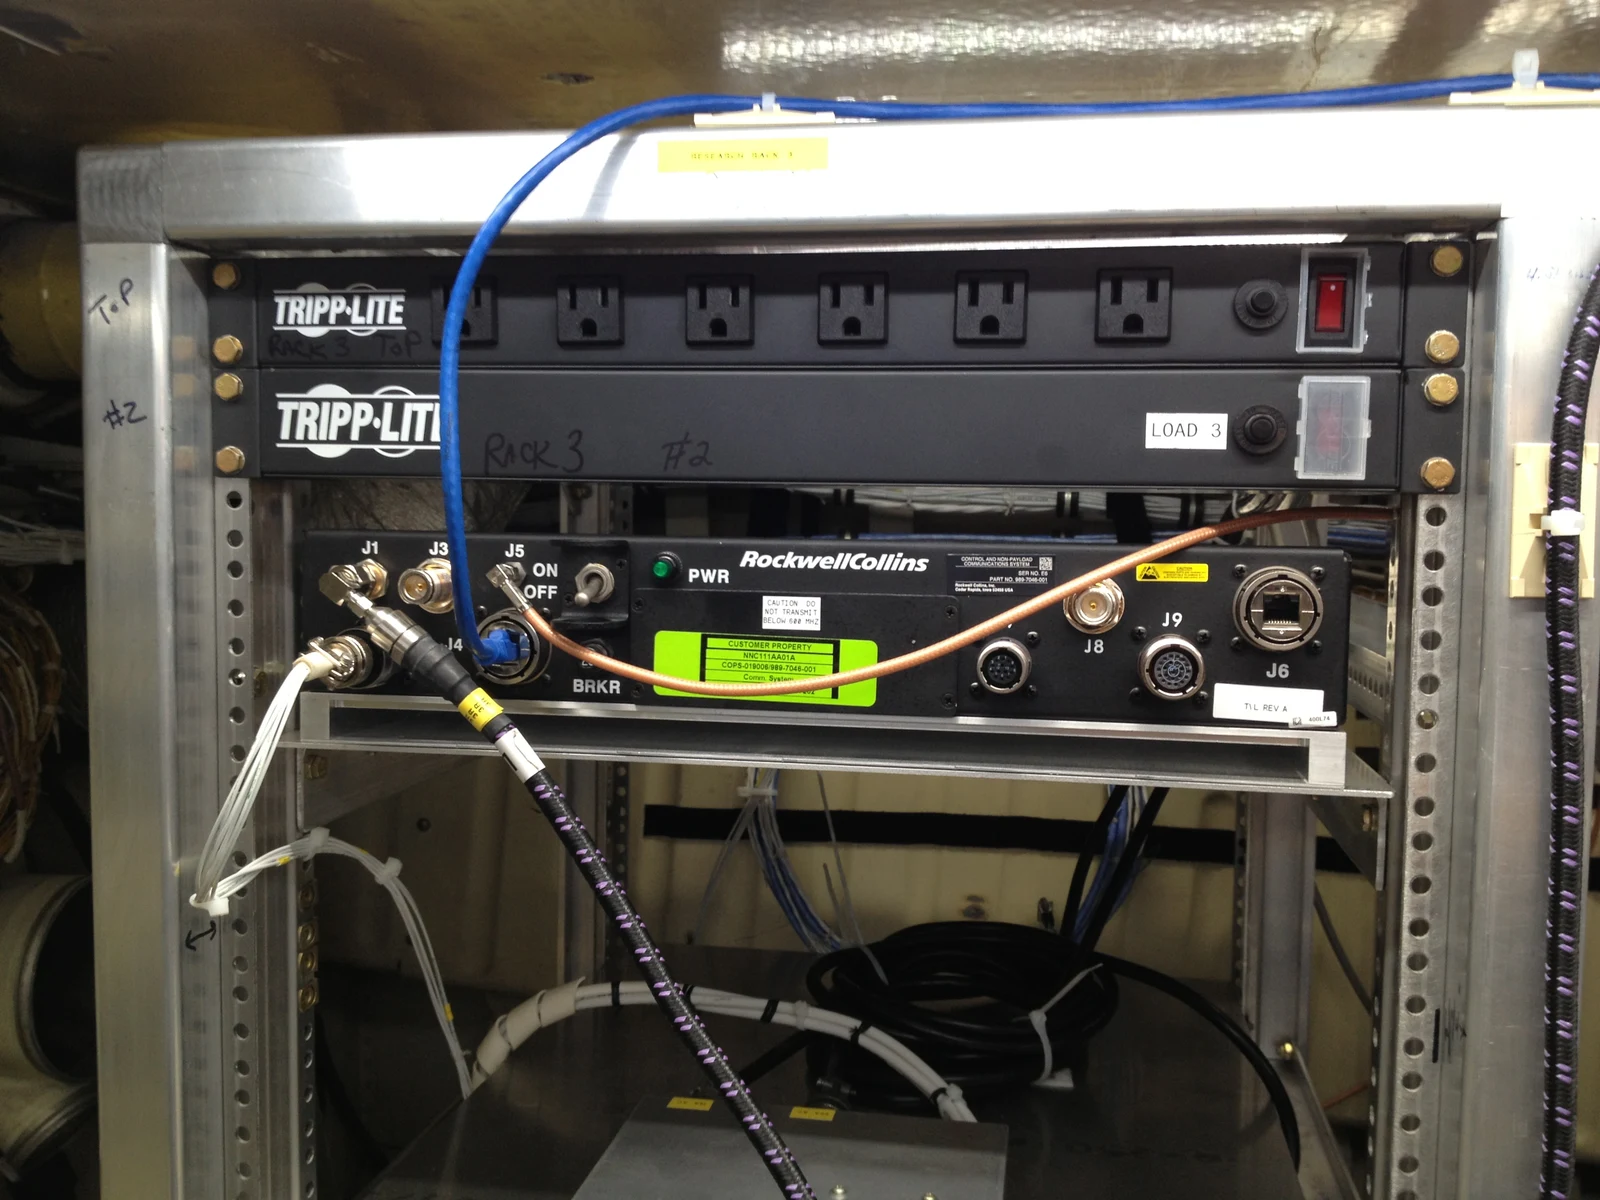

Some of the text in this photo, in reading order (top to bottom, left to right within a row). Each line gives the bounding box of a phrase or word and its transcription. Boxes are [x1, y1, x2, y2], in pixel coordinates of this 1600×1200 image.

[691, 151, 744, 159] RESEARH
[335, 335, 350, 358] 3
[103, 399, 147, 430] #2
[1151, 422, 1222, 438] LOAD 3
[562, 429, 585, 474] 3
[361, 541, 379, 555] J1
[428, 541, 449, 556] J3
[504, 543, 525, 558] J5
[739, 550, 930, 573] RockwellCollins
[532, 562, 559, 578] ON
[688, 568, 730, 584] PWR
[524, 584, 559, 600] OFF
[767, 599, 798, 607] CAUTION
[782, 608, 818, 616] TRANSMIT
[1161, 611, 1183, 628] J9
[763, 616, 819, 626] BELOW 600 MHZ
[445, 637, 463, 652] J4
[728, 640, 813, 651] CUSTOMER PROPERTY
[1084, 639, 1104, 654] J8
[743, 652, 796, 661] NNC111AA01A
[1265, 662, 1290, 679] J6
[572, 678, 621, 694] BRKR
[1262, 704, 1279, 712] REV
